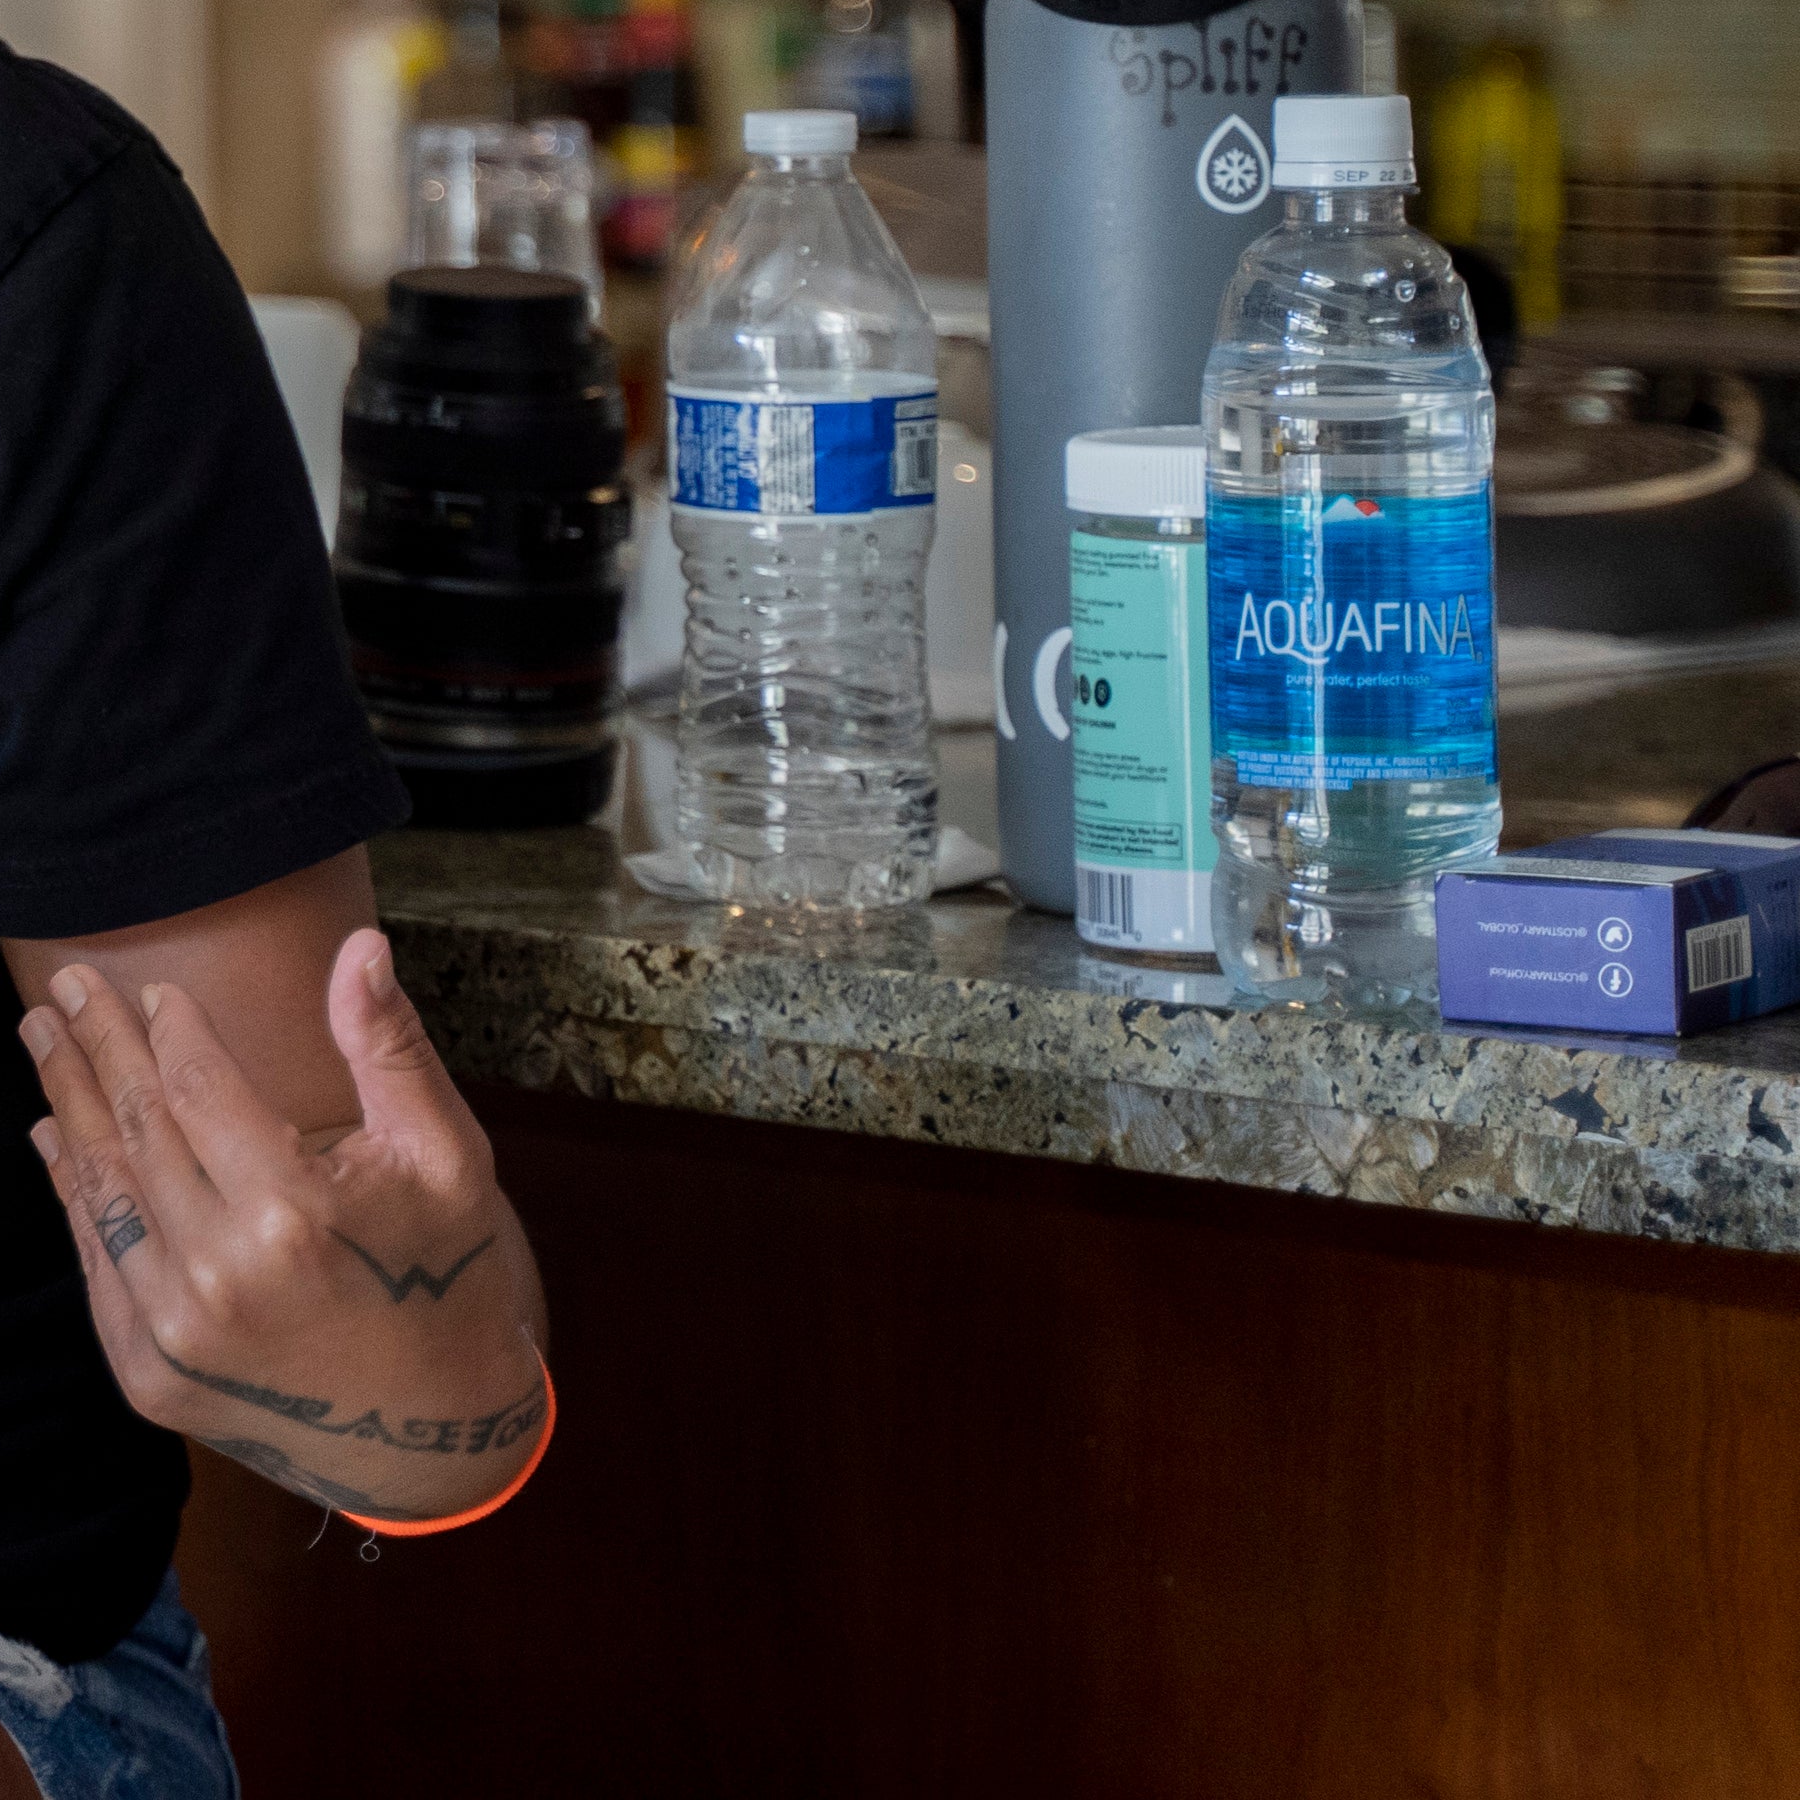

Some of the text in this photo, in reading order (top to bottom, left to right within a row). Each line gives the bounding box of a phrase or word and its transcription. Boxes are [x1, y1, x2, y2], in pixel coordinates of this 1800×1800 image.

[1333, 169, 1370, 183] SEP
[1379, 169, 1397, 182] 22
[1235, 591, 1477, 665] AQUAFINA
[1285, 674, 1313, 687] pure
[1357, 673, 1400, 689] perfect
[1402, 674, 1431, 687] taste
